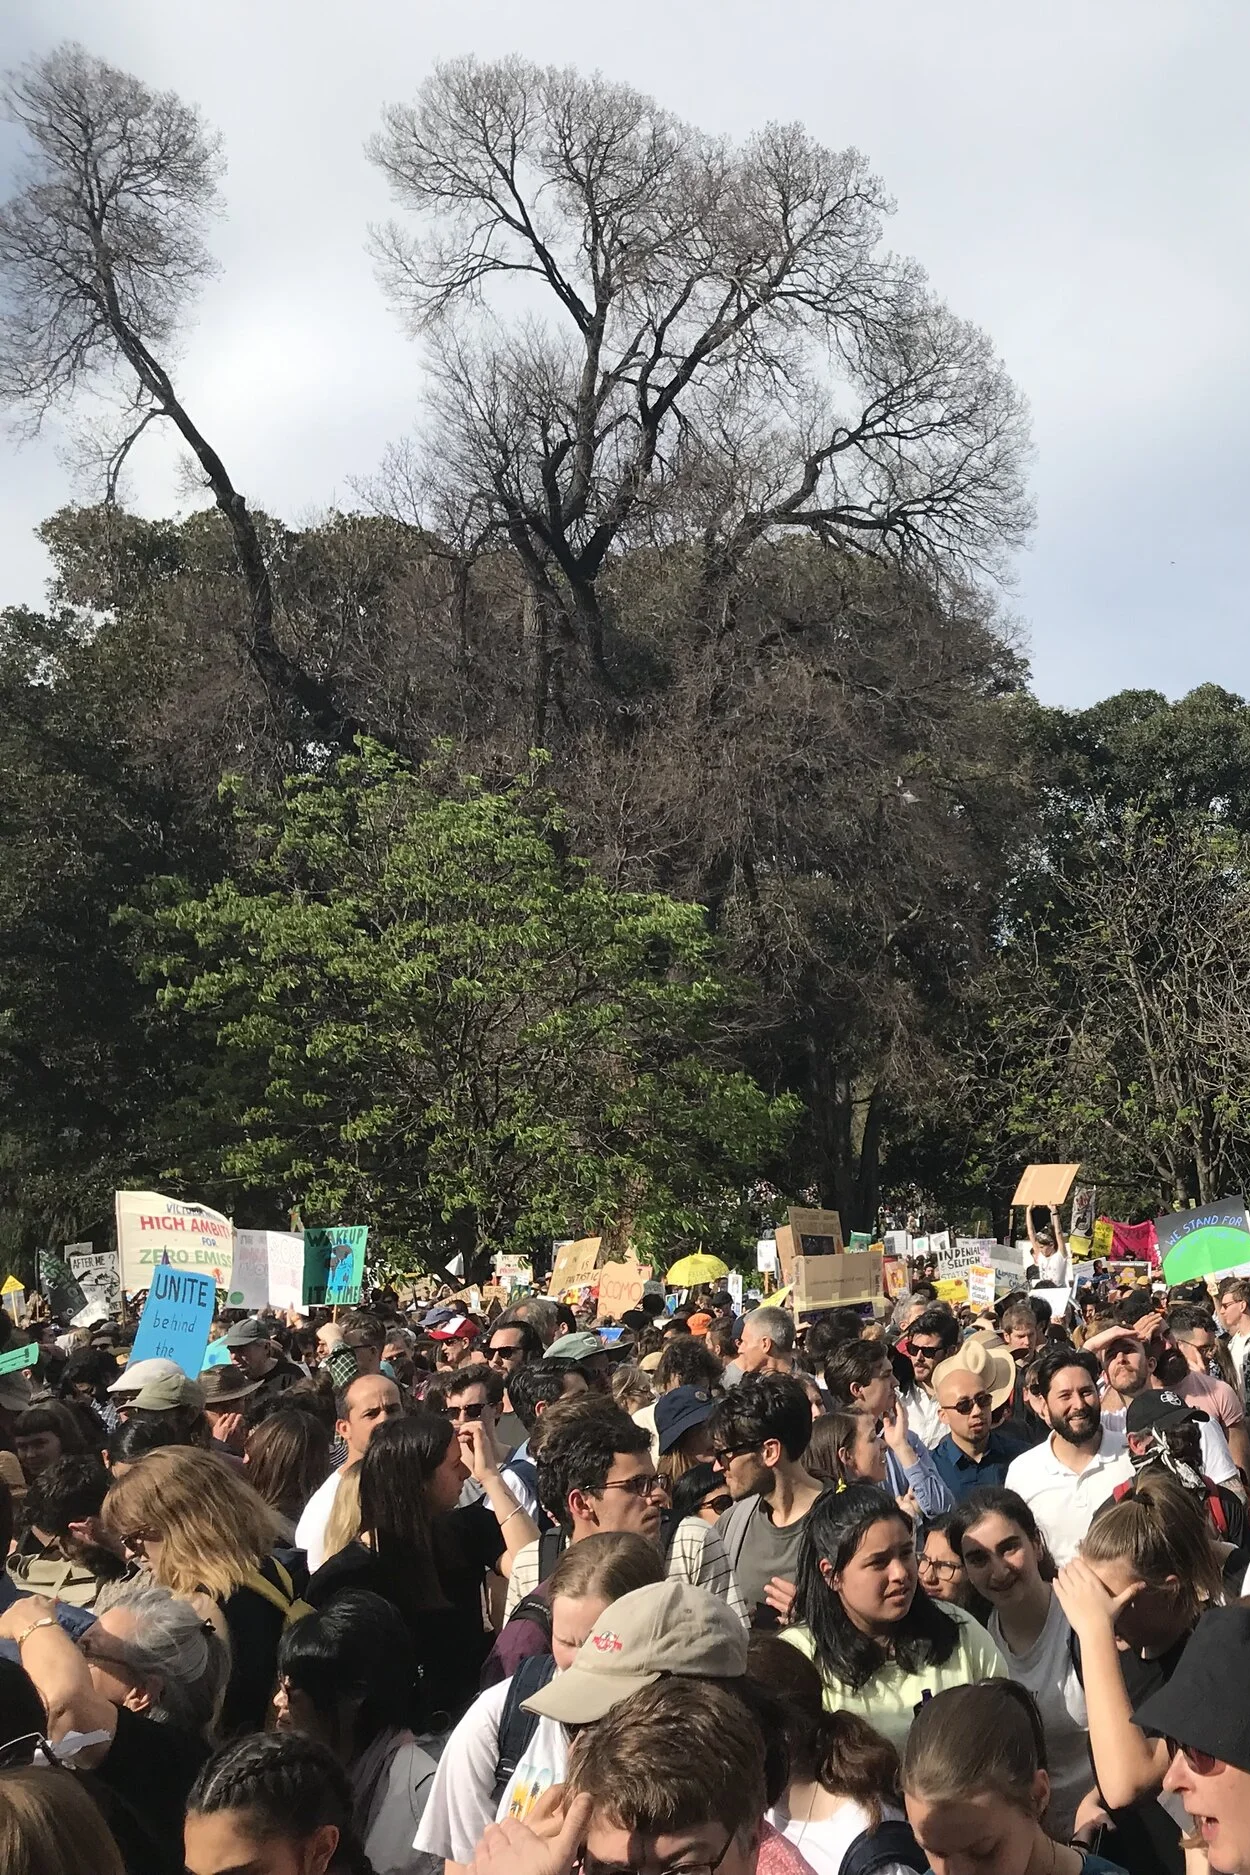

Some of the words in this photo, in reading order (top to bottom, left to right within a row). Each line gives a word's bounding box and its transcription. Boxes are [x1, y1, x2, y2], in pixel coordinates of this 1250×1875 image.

[140, 1216, 185, 1231] HIGH
[1165, 1229, 1181, 1246] WE
[1183, 1215, 1218, 1232] STAND
[1222, 1215, 1242, 1227] FOR
[202, 1237, 217, 1248] FOR
[73, 1256, 93, 1269] AFTER
[95, 1255, 105, 1267] ME
[140, 1249, 189, 1264] ZERO
[155, 1274, 208, 1307] UNITE
[153, 1309, 197, 1333] behind
[156, 1339, 174, 1357] the
